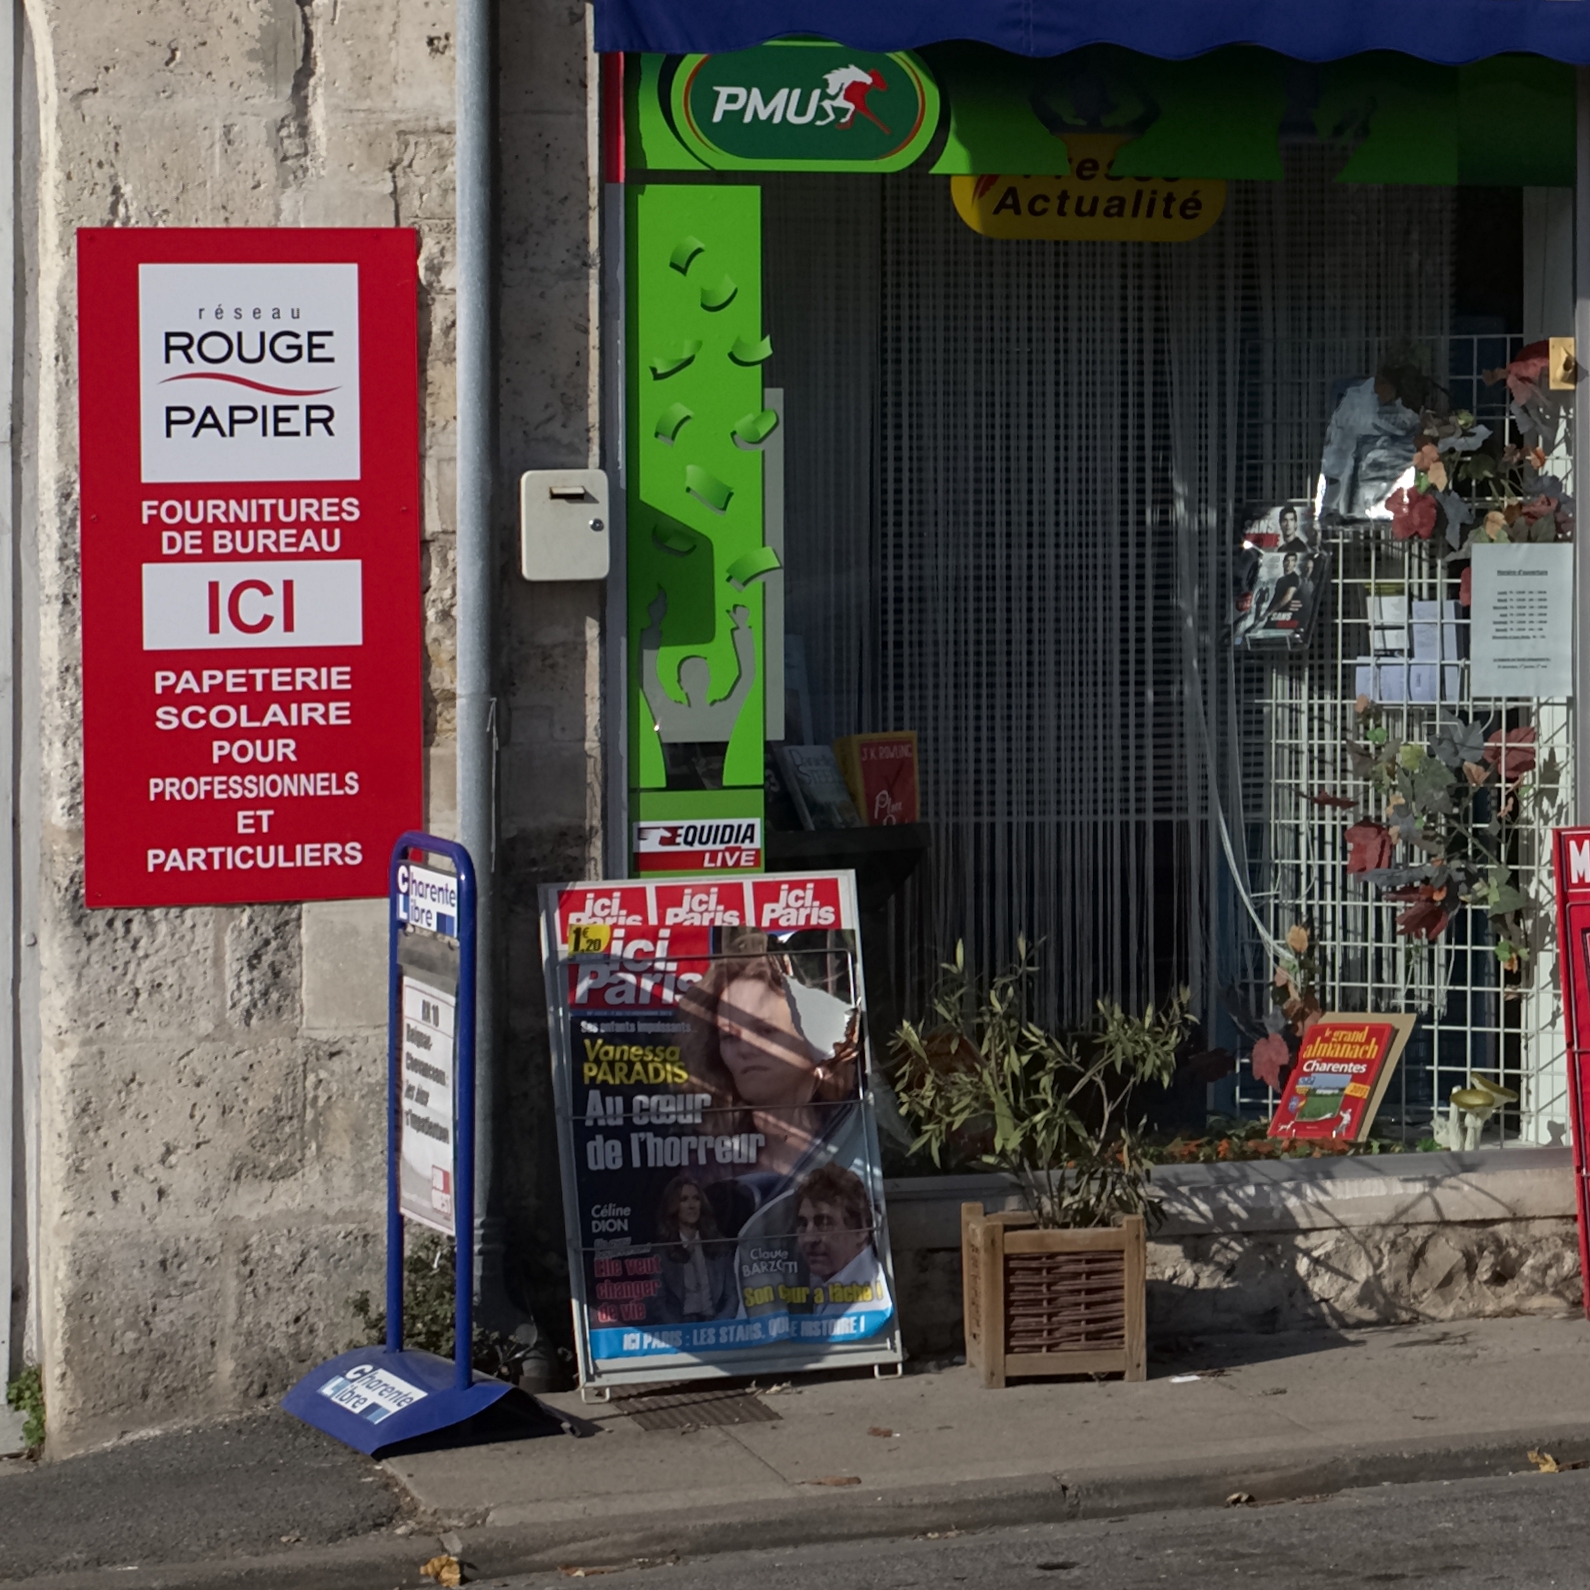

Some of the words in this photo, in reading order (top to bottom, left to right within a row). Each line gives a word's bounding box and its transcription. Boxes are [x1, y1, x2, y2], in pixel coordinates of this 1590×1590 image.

[711, 85, 822, 127] PMU
[992, 185, 1203, 222] Actualité
[198, 304, 302, 320] réseau
[163, 330, 335, 365] ROUGE
[164, 404, 335, 439] PAPIER
[141, 498, 360, 525] FOURNITURES
[161, 530, 204, 554] DE
[212, 528, 341, 554] BUREAU
[206, 579, 295, 635] ICI
[154, 666, 352, 694] PAPETERIE
[155, 702, 351, 729] SCOLAIRE
[212, 738, 297, 764] POUR
[148, 771, 360, 802] PROFESSIONNELS
[236, 811, 274, 834] ET
[673, 823, 756, 848] EQUIDIA
[146, 842, 363, 873] PARTICULIERS
[703, 850, 756, 868] LIVE
[1331, 1026, 1369, 1043] grand
[584, 1039, 680, 1061] Vanessa
[1303, 1037, 1378, 1059] almanach
[584, 1062, 689, 1085] PARADIS
[1303, 1060, 1367, 1073] Charentes
[585, 1090, 623, 1126] Au
[632, 1093, 711, 1125] cœur
[586, 1135, 622, 1171] de
[630, 1133, 765, 1168] l'horreur
[592, 1219, 628, 1233] DION
